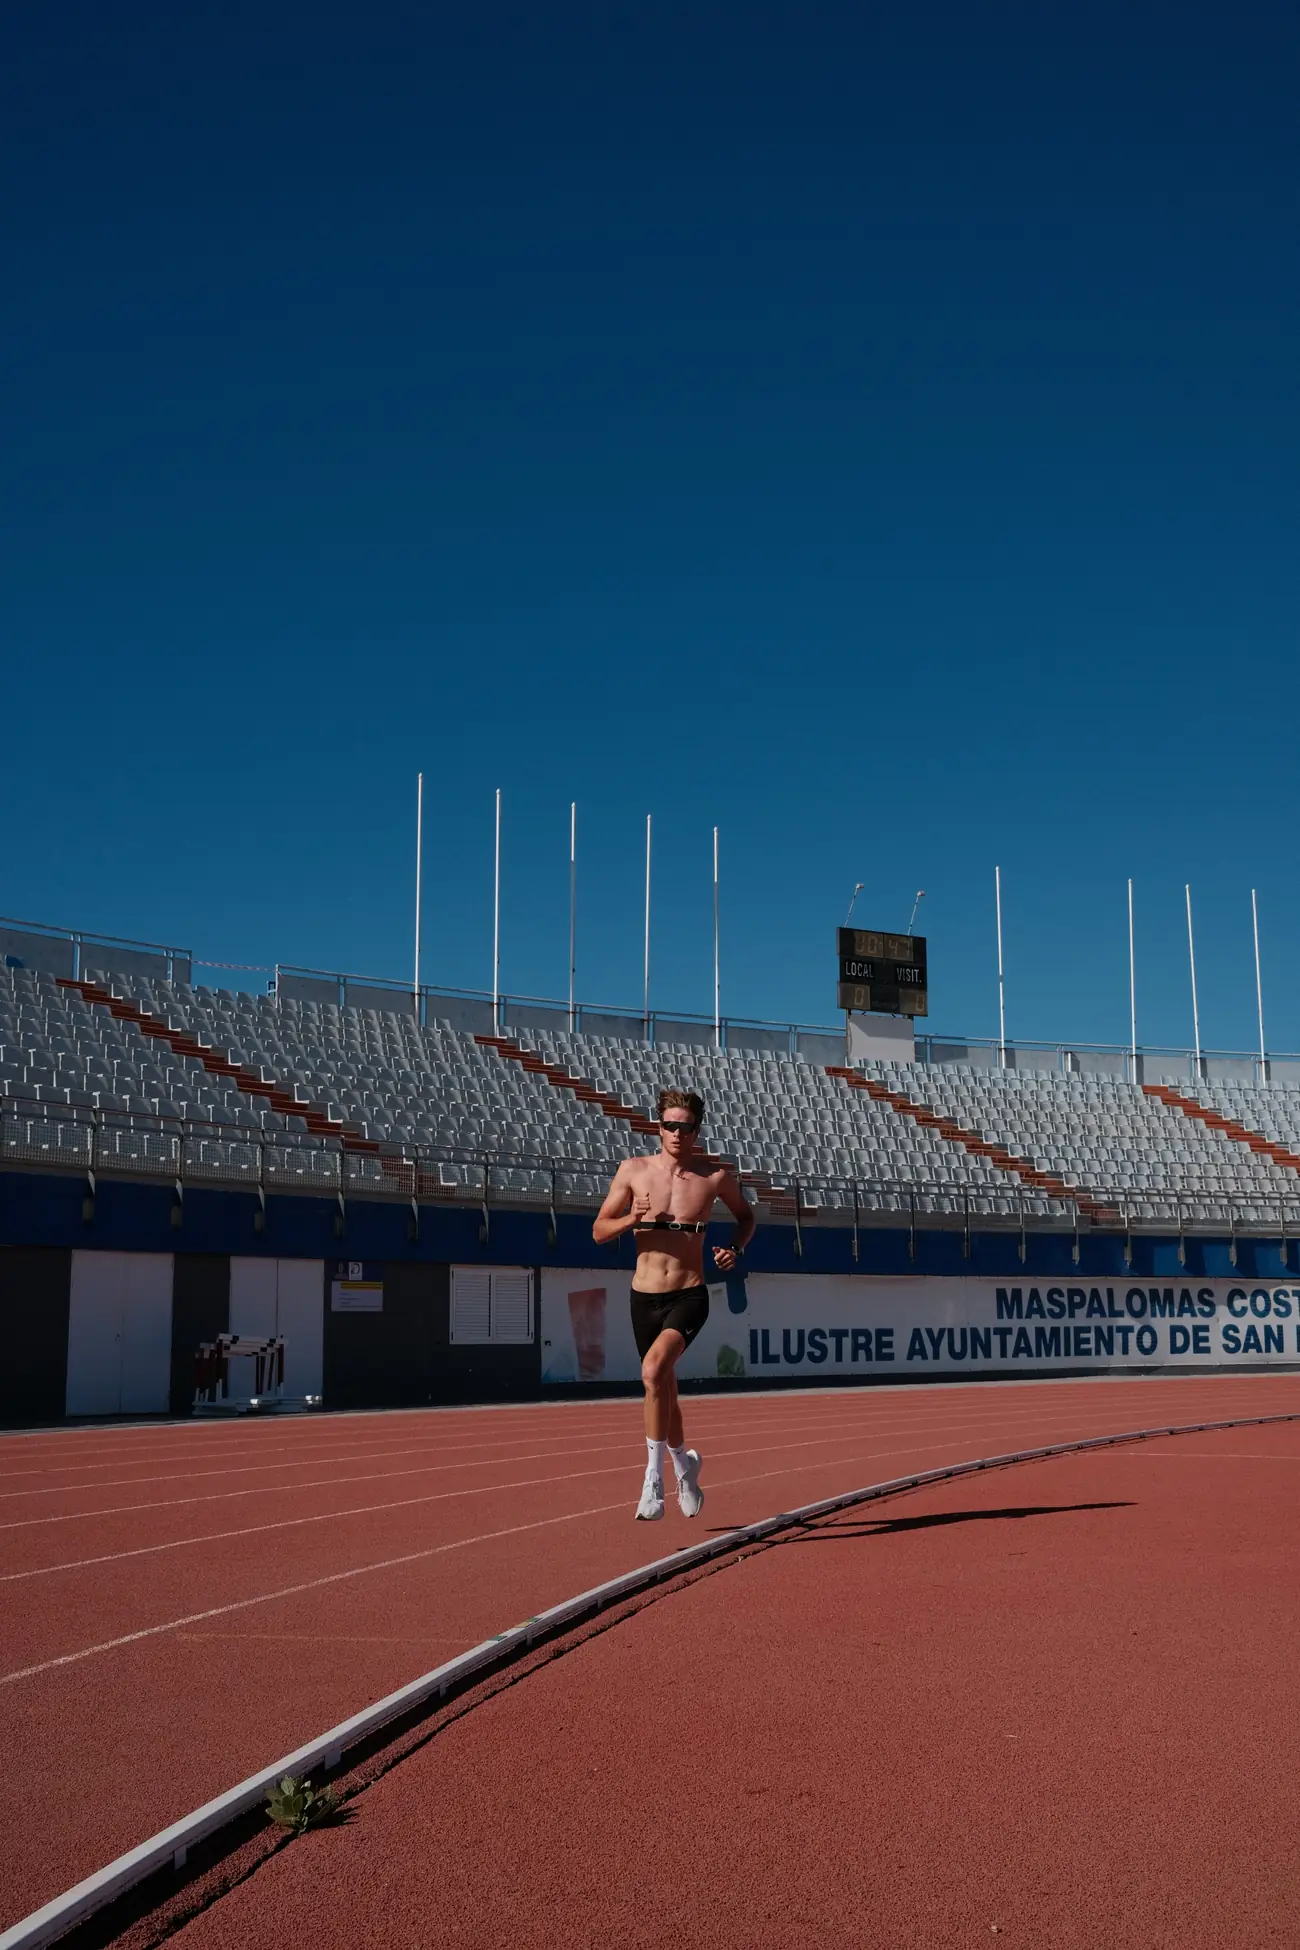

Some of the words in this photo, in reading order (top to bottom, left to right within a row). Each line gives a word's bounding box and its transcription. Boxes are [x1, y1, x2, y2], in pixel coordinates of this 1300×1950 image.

[845, 961, 874, 978] LOCAL
[896, 967, 922, 983] VISIT.
[995, 1287, 1216, 1319] MASPALOMAS
[749, 1328, 895, 1364] ILUSTRE
[906, 1324, 1158, 1361] AYUNTAMIENTO
[1169, 1324, 1212, 1354] DE
[1222, 1323, 1285, 1354] SAN
